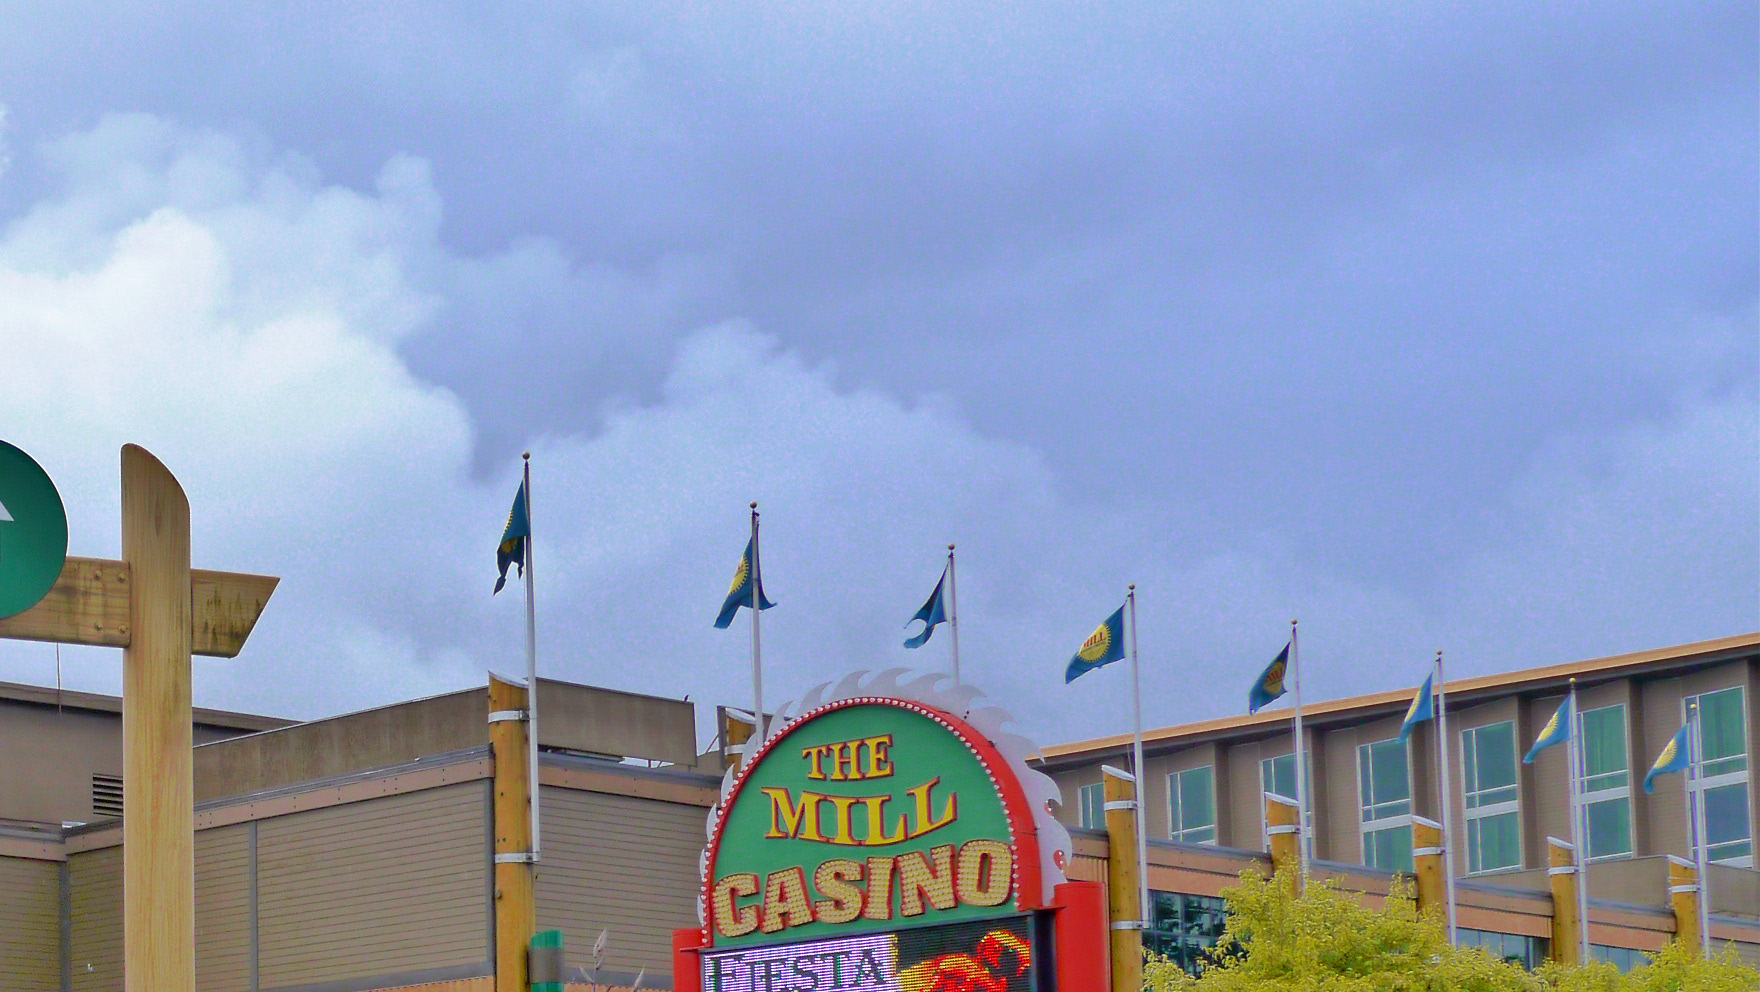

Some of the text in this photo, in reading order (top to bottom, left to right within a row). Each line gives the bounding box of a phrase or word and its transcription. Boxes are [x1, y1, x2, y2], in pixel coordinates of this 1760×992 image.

[802, 734, 895, 781] THE
[761, 776, 959, 847] MILL
[712, 839, 1015, 938] CASINO
